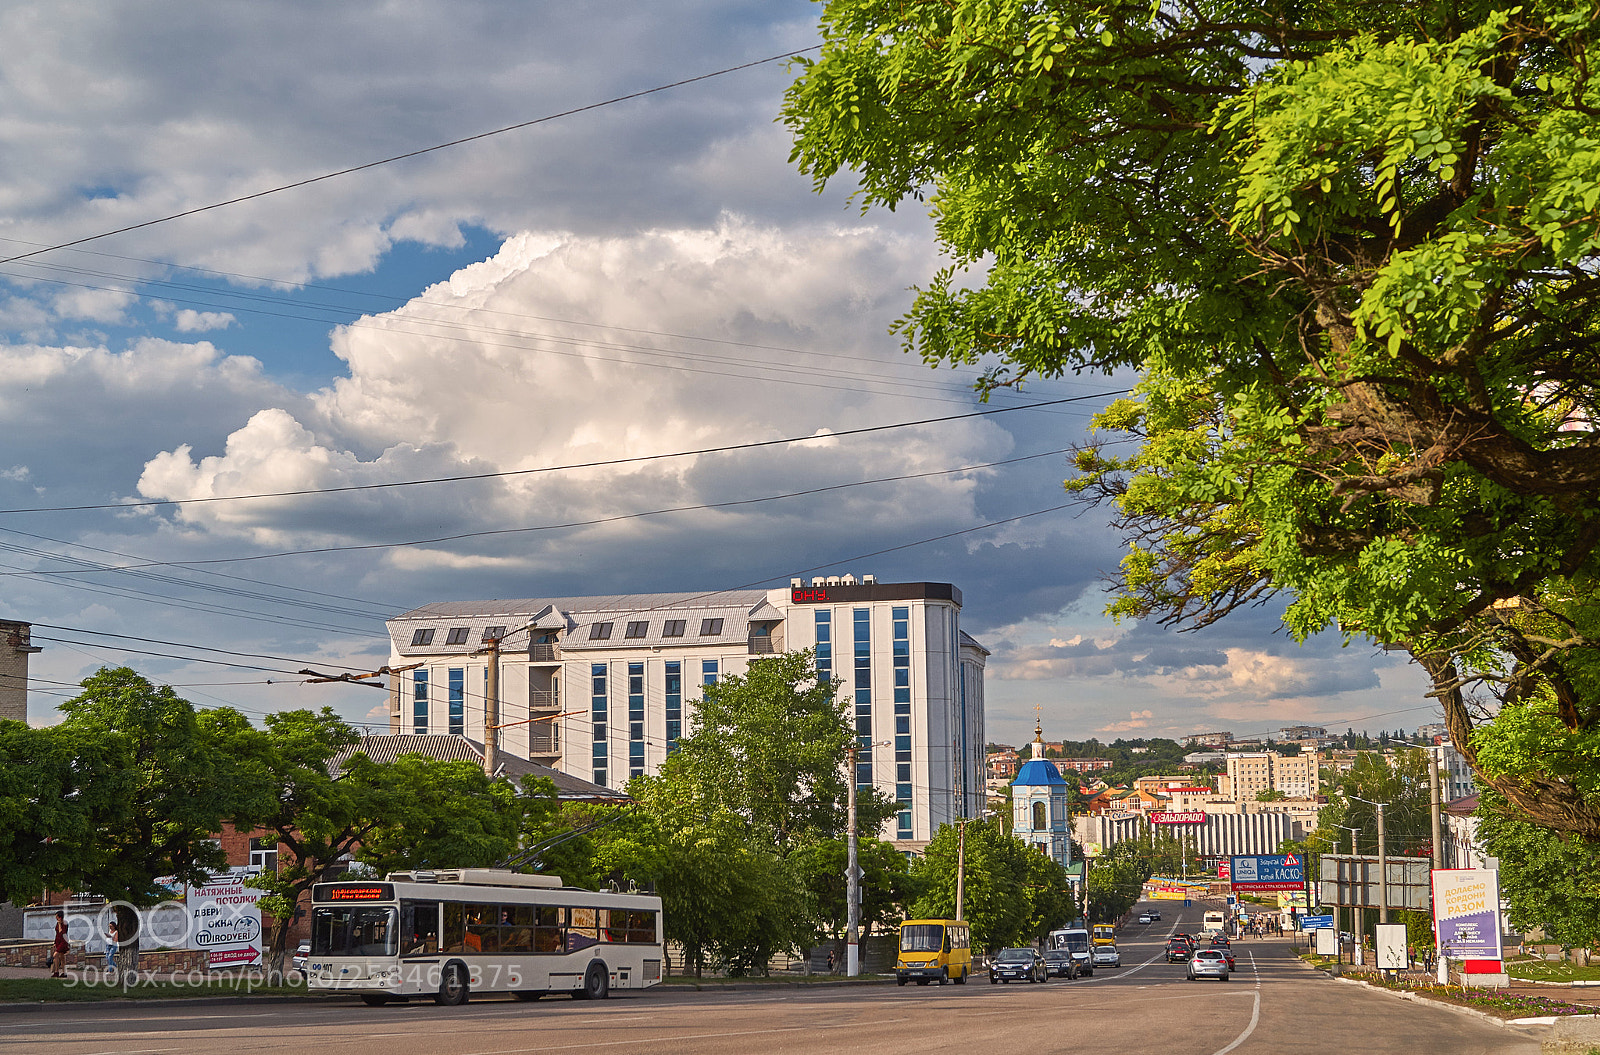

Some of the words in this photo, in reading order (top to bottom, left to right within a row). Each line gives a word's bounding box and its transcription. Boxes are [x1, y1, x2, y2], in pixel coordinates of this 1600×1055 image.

[1274, 868, 1300, 880] КАСКО
[195, 887, 242, 897] НАТЯЖНЫЕ
[332, 889, 340, 899] 10
[1445, 882, 1486, 897] ДОЛАЄМО
[216, 896, 257, 905] ПОТОЛКИ
[1446, 892, 1486, 904] КОРДОНИ
[194, 907, 223, 918] ДВЕРИ
[1448, 900, 1485, 915] РАЗОМ
[208, 920, 233, 928] ОКНА
